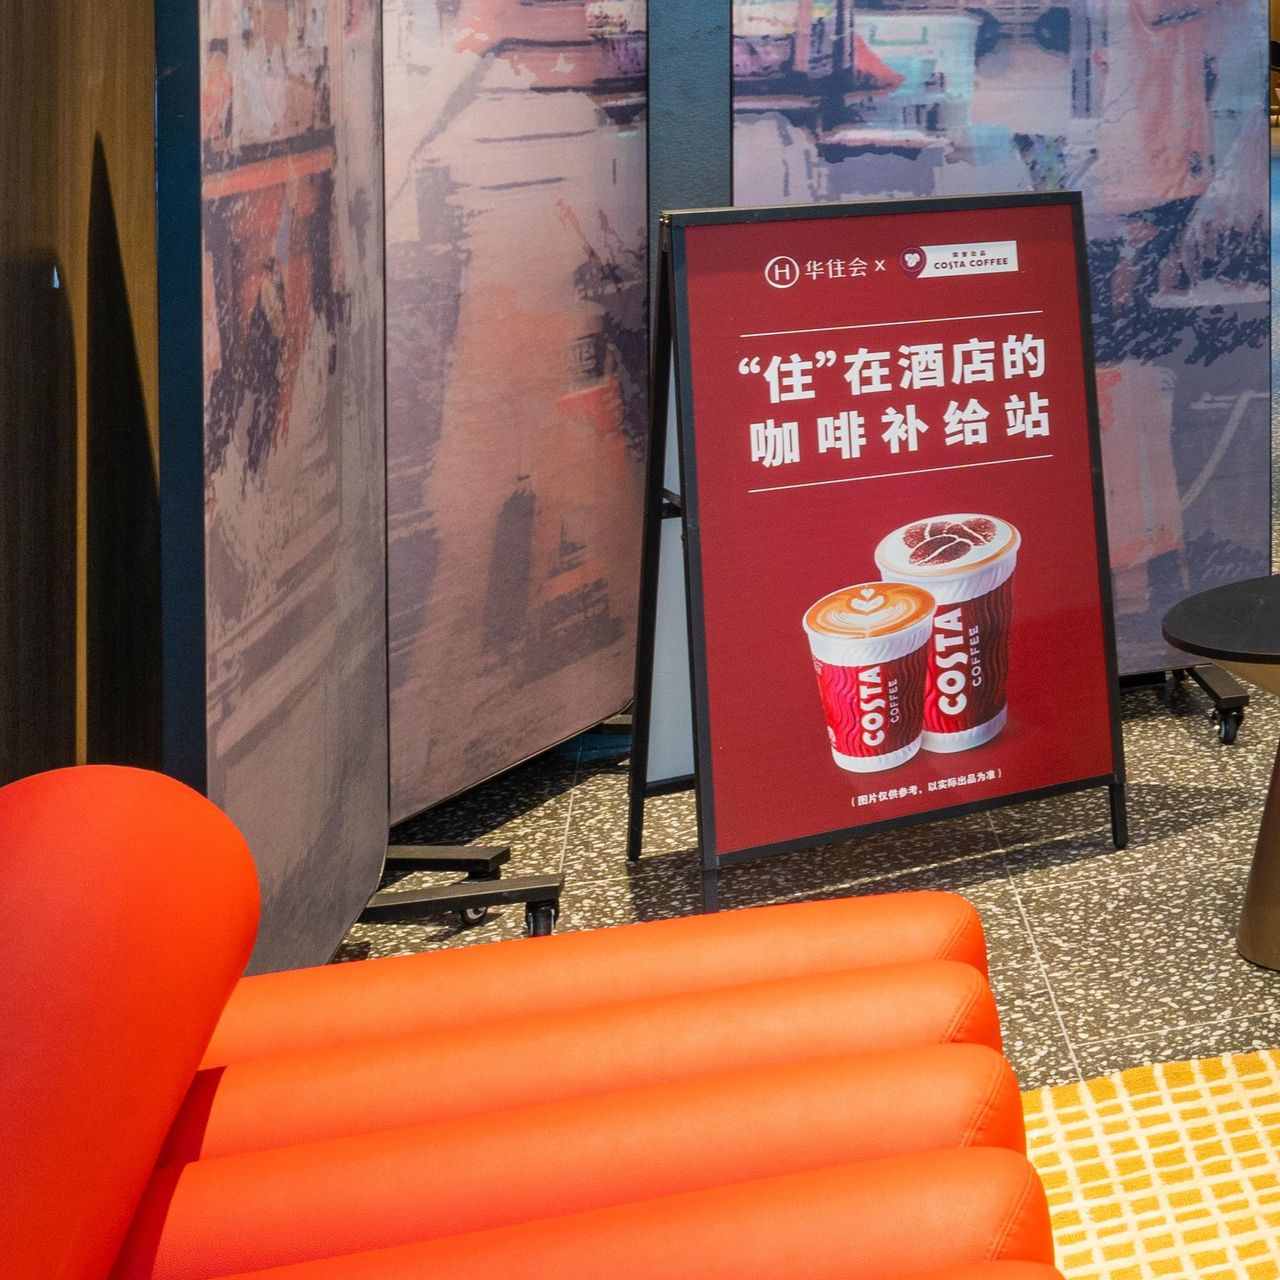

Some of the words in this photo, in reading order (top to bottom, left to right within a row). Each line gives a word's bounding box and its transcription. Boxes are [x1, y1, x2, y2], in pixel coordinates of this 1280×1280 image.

[804, 257, 868, 281] 华住会
[933, 260, 966, 270] COSTA
[969, 257, 1009, 268] COFFEE
[738, 333, 1046, 404] “住”在酒店的
[749, 391, 1050, 468] 咖啡补给站
[934, 607, 969, 715] COSTA
[968, 625, 983, 688] COFFEE
[858, 665, 886, 747] COSTA
[889, 678, 899, 723] COFFEE
